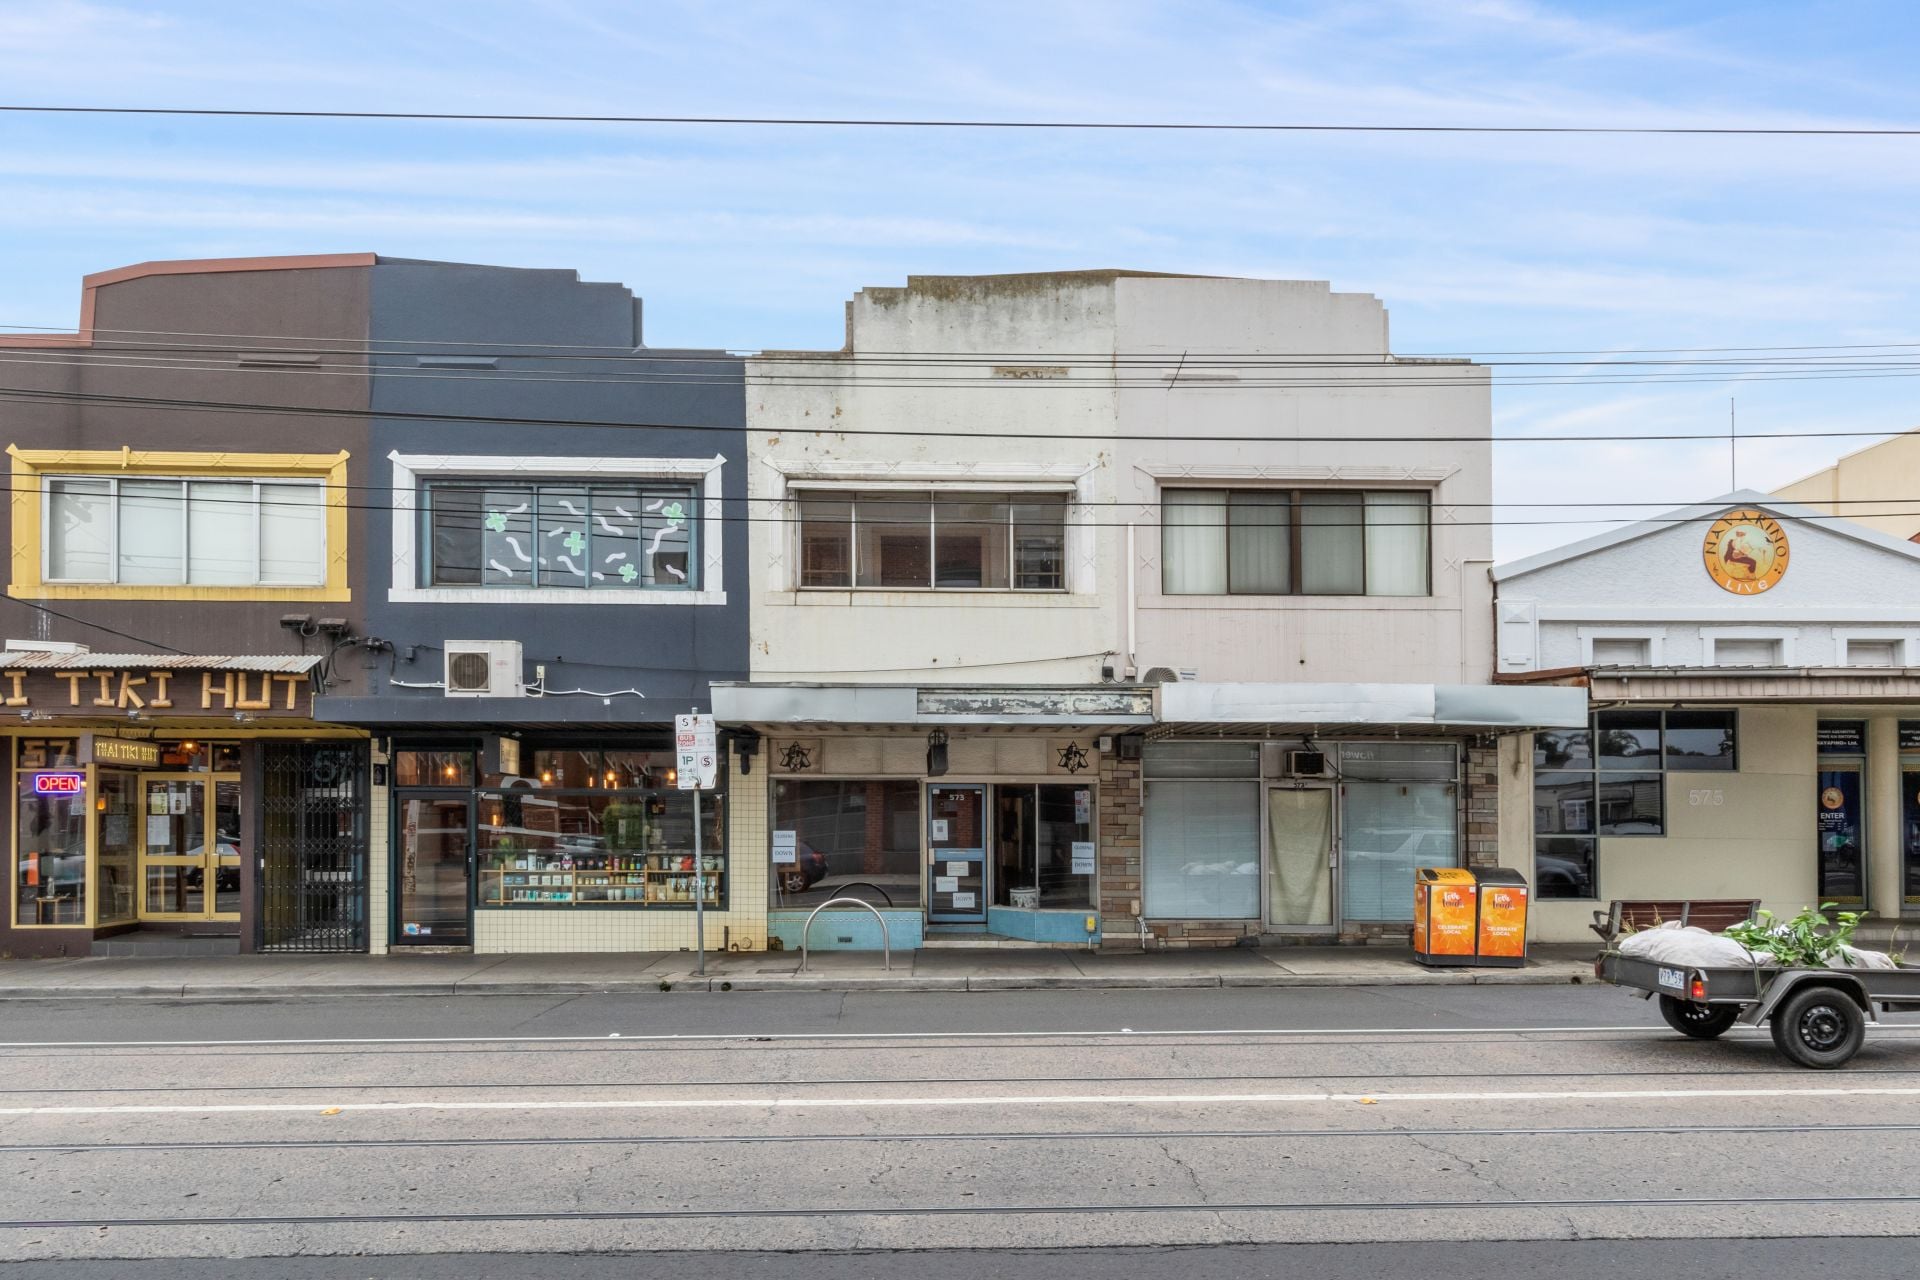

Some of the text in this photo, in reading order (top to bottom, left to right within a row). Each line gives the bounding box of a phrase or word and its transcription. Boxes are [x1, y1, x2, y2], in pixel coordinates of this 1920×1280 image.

[1705, 512, 1787, 557] NAVARINO
[55, 671, 173, 708] TIKI
[202, 671, 309, 710] HUT
[95, 741, 118, 758] THAI
[120, 743, 139, 760] TIKI
[38, 777, 78, 791] OPEN
[1689, 789, 1724, 806] 575
